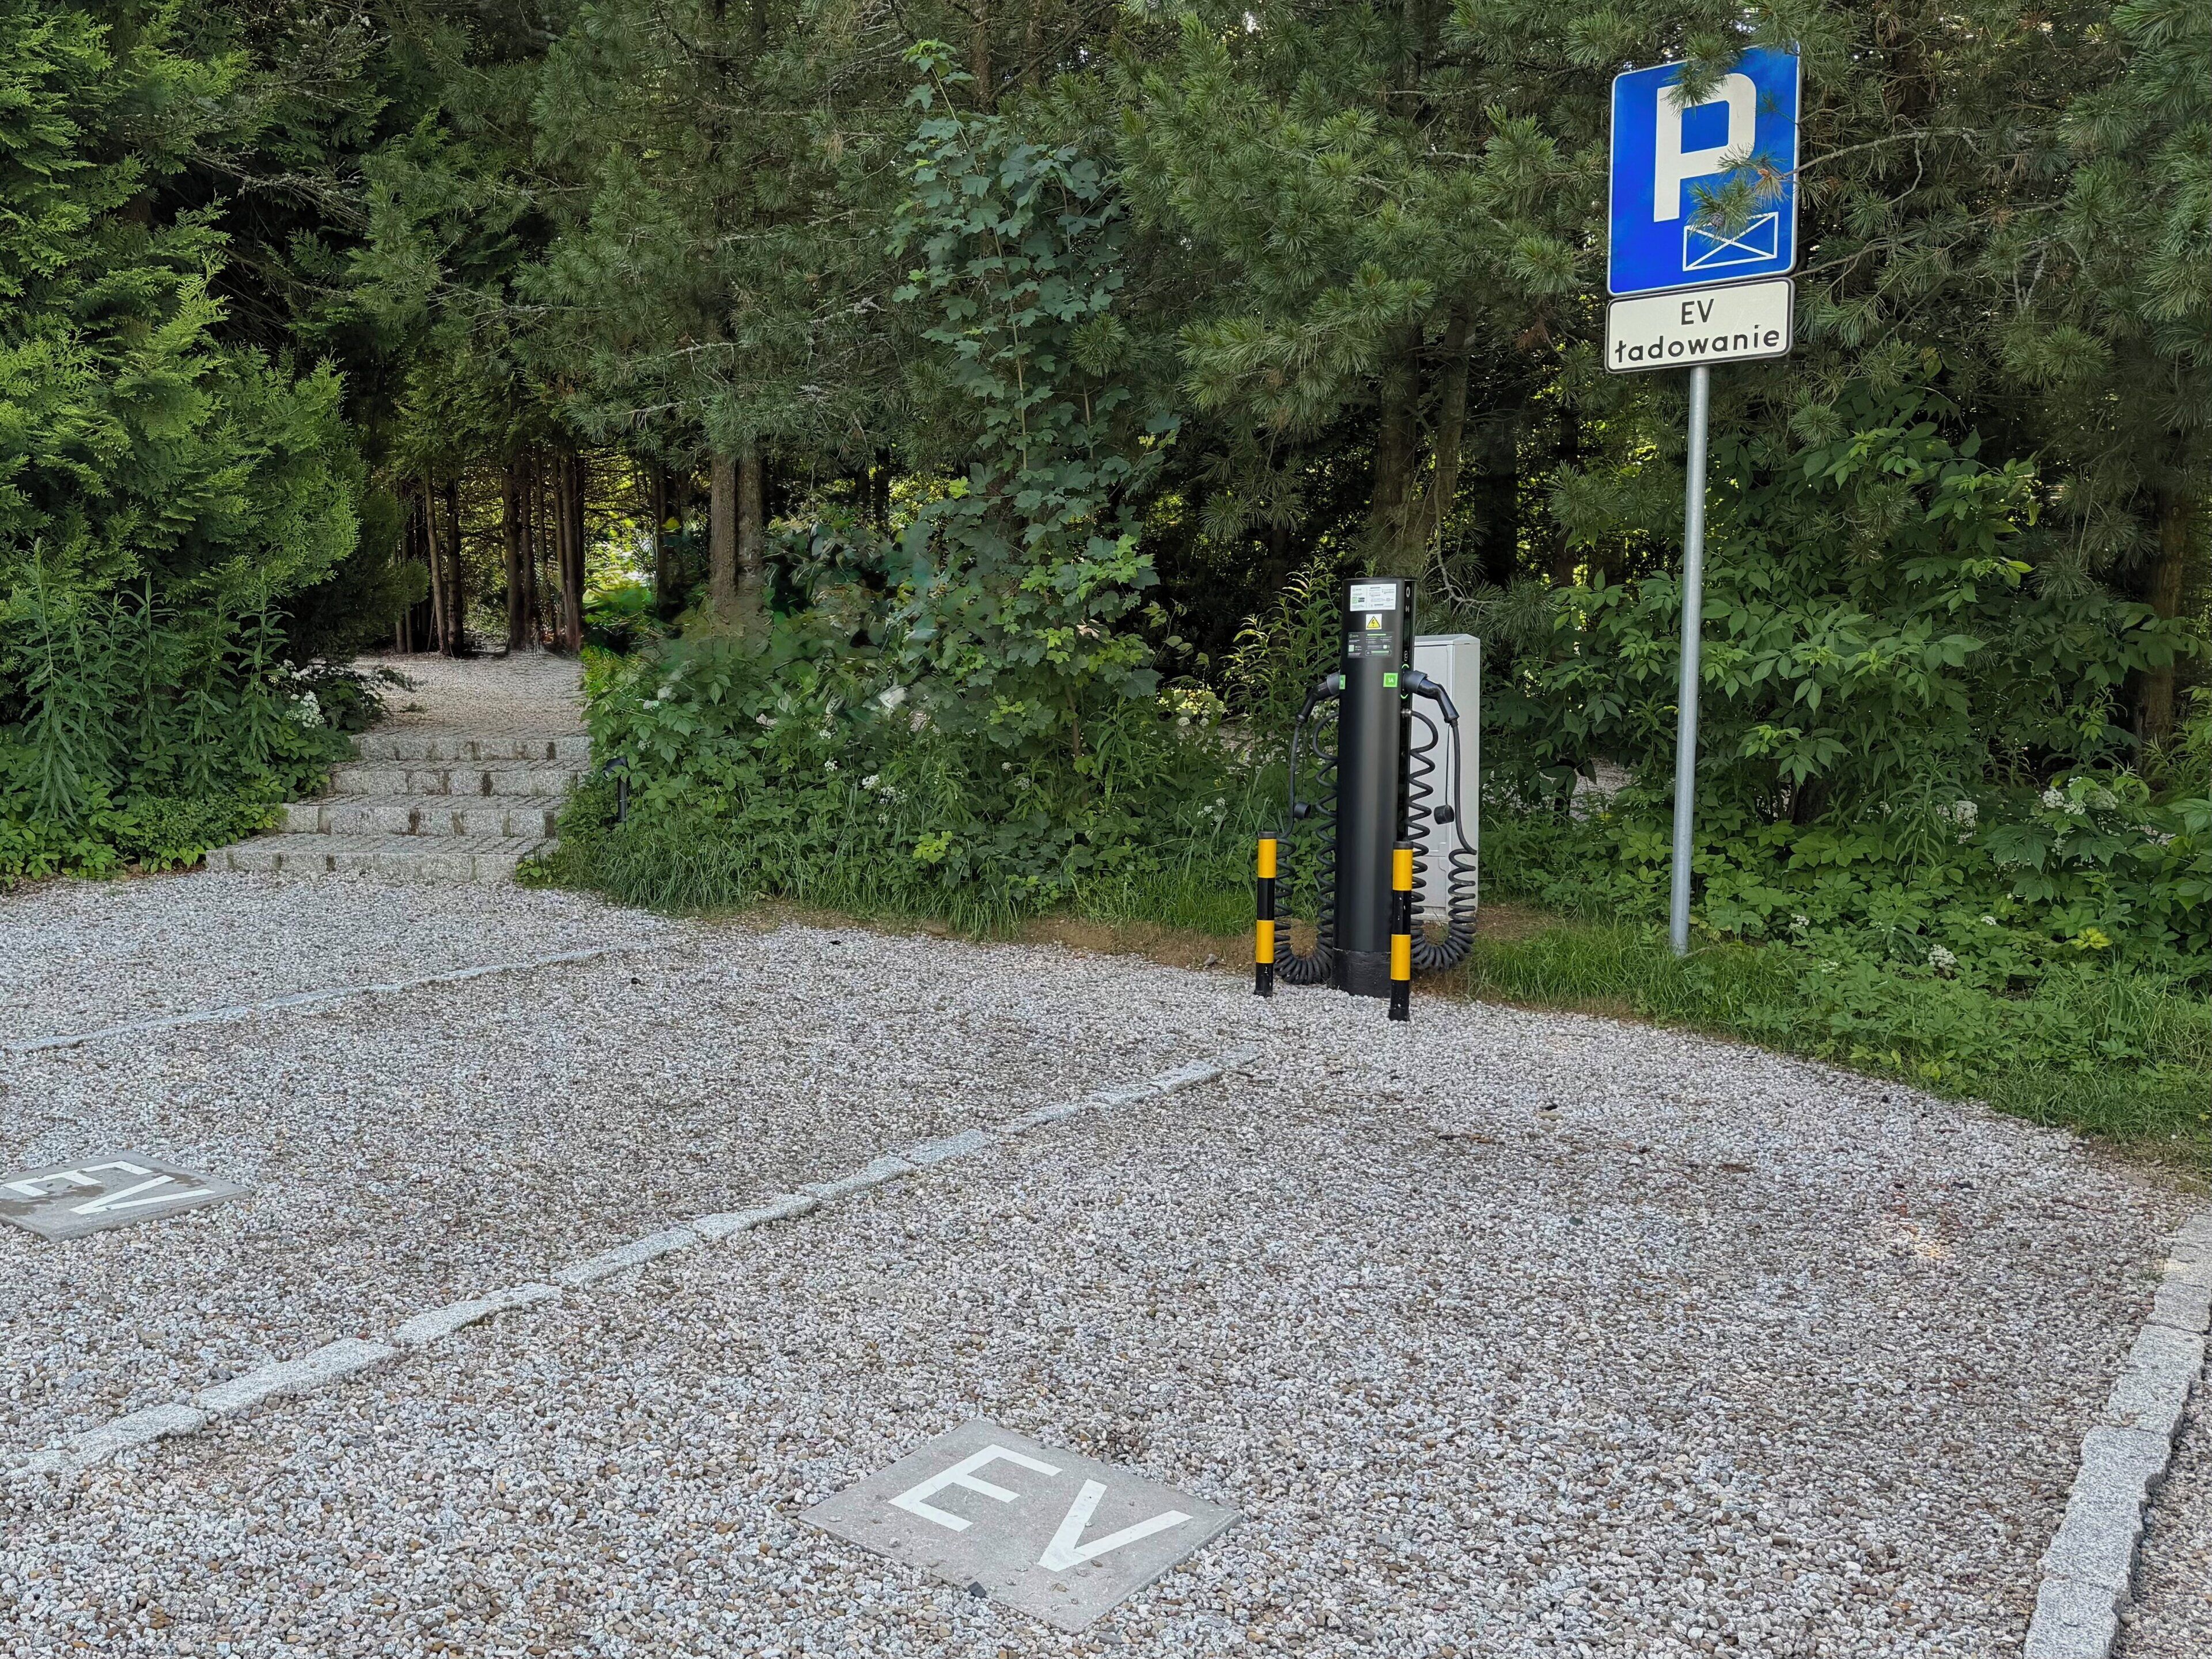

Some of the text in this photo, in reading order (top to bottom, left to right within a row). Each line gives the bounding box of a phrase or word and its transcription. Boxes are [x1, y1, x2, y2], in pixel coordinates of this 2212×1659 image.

[1654, 73, 1757, 222] P
[1681, 298, 1714, 325] EV
[1615, 324, 1780, 363] ładowanie
[3, 1160, 215, 1214] EV
[887, 1444, 1193, 1572] EV
